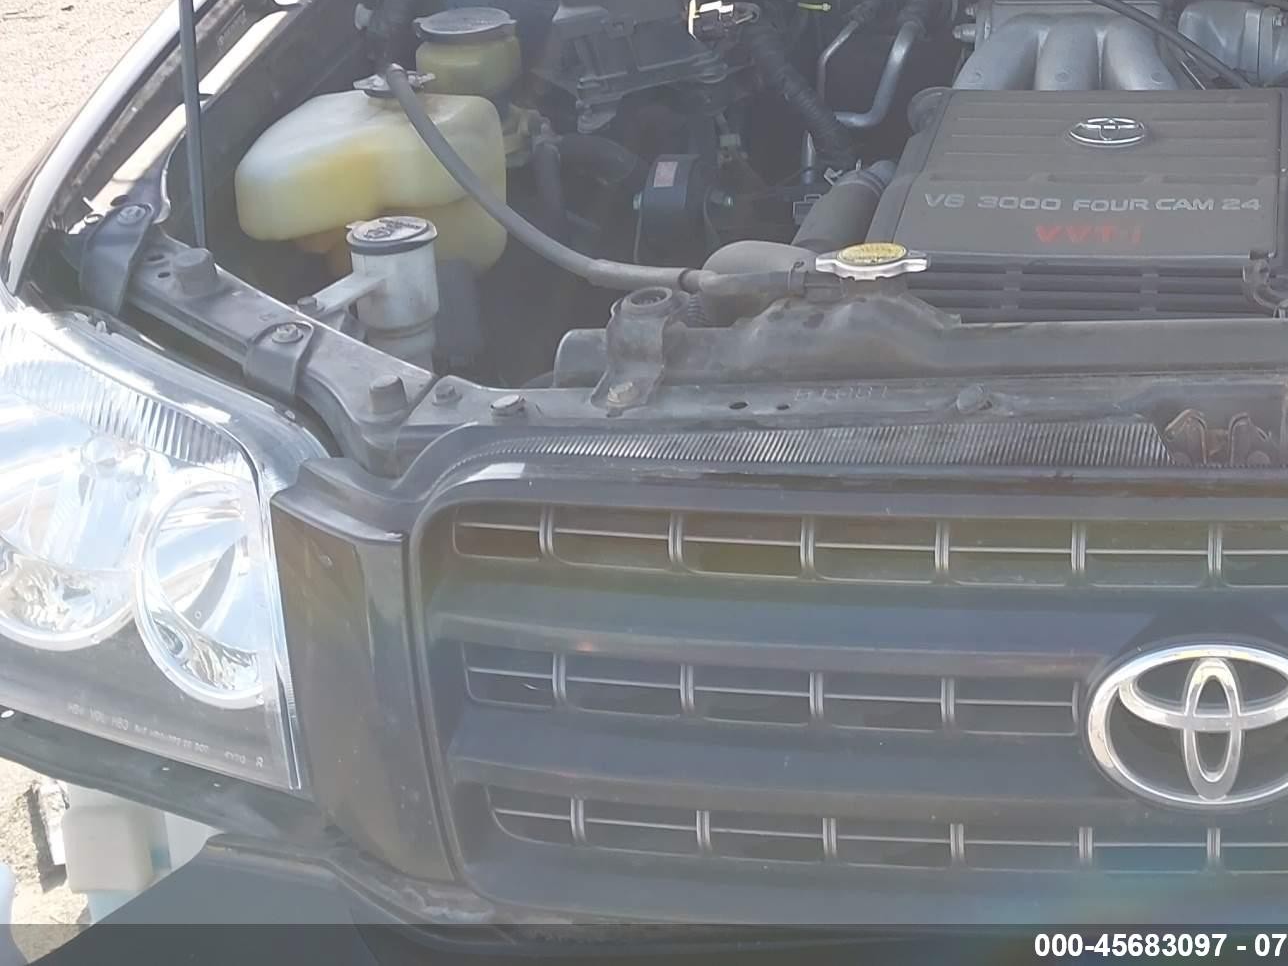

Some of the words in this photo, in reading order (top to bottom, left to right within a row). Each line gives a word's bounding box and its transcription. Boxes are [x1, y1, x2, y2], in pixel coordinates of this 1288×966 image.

[924, 193, 965, 208] V6
[977, 195, 1062, 211] 3000
[1072, 198, 1150, 212] FOUR
[1155, 198, 1215, 211] CAM
[1221, 198, 1262, 211] 24
